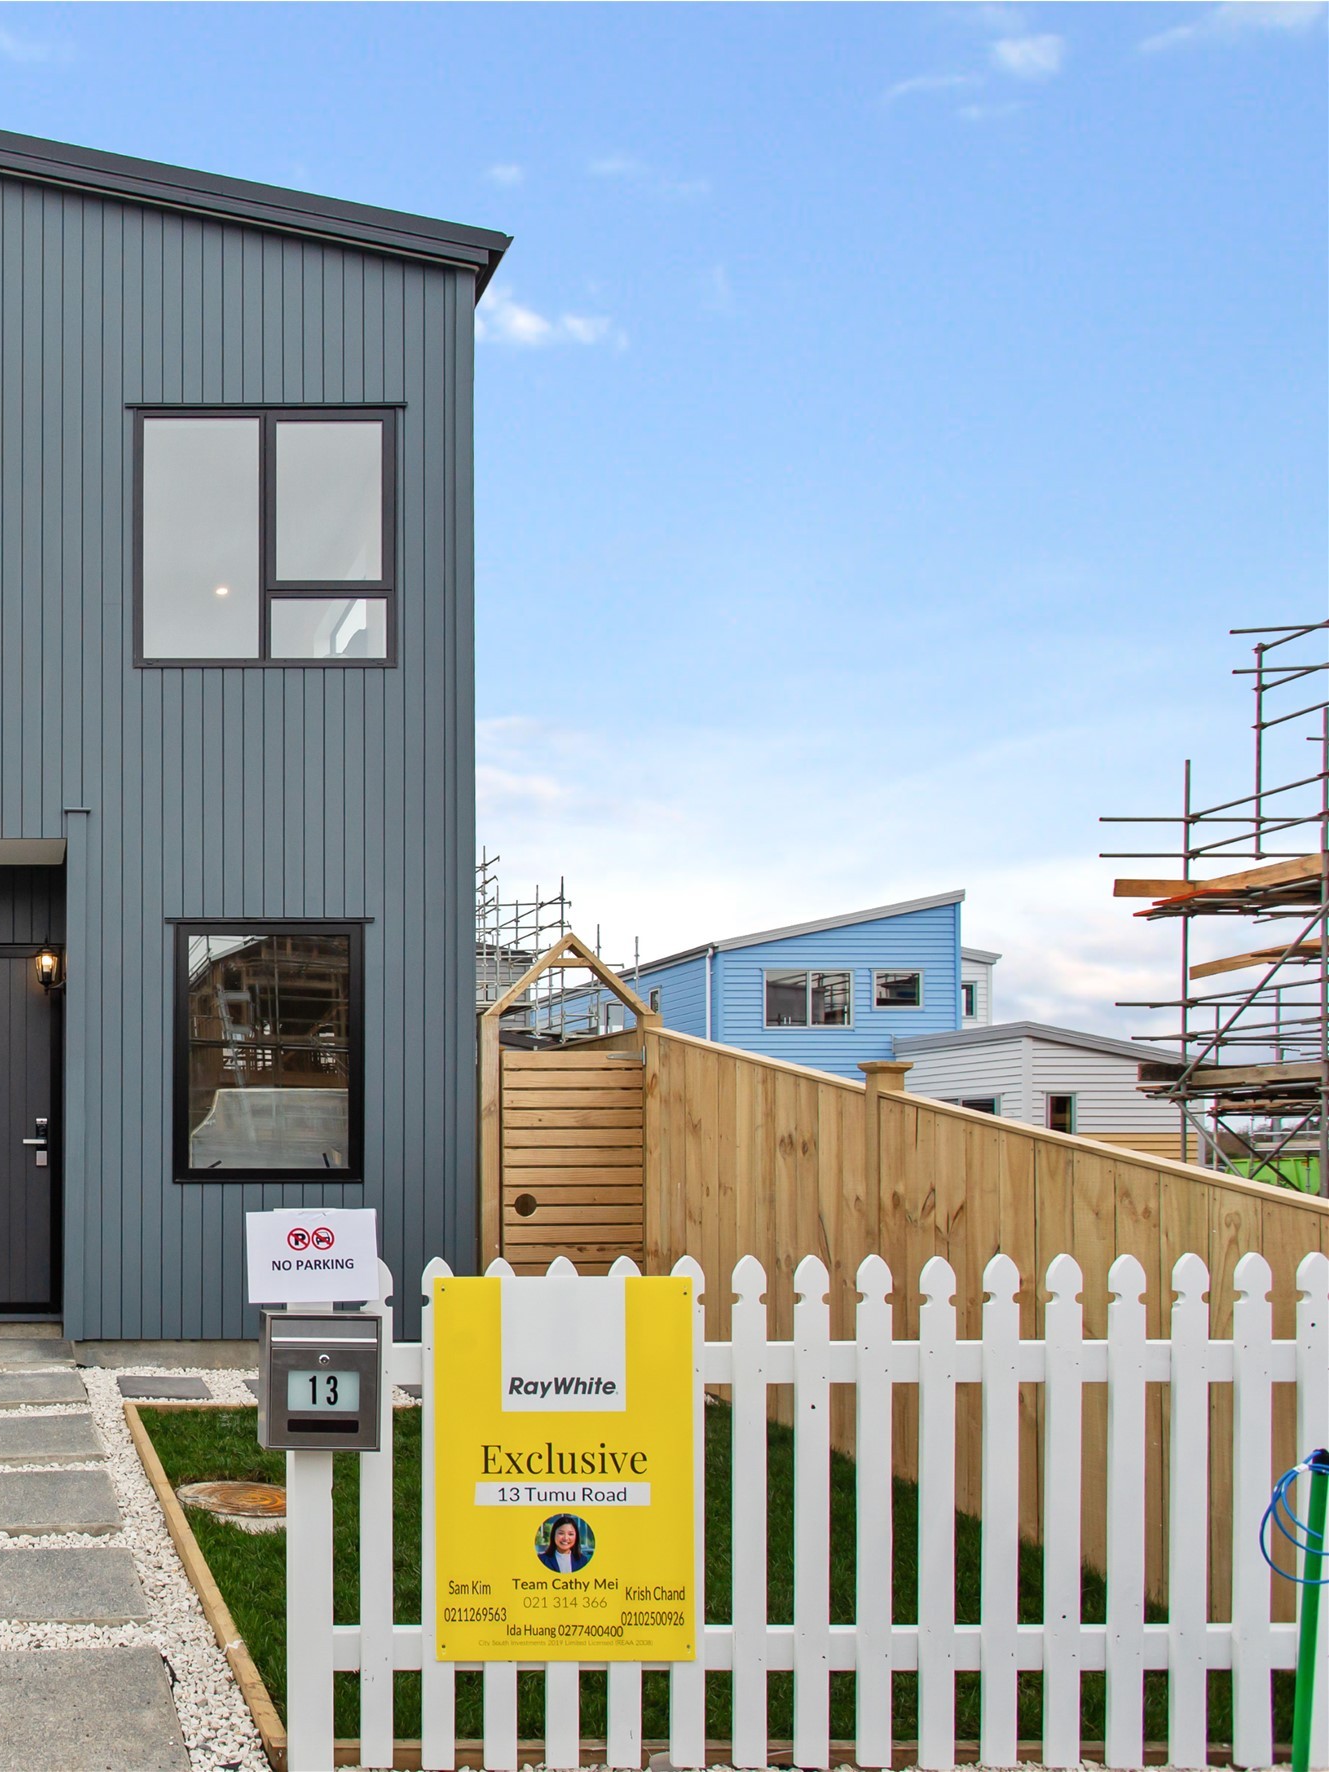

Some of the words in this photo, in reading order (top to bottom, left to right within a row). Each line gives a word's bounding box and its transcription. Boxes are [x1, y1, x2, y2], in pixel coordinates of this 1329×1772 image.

[271, 1260, 292, 1271] NO
[296, 1258, 354, 1270] PARKING
[309, 1375, 339, 1406] 13
[481, 1442, 648, 1475] Exclusive
[498, 1487, 520, 1502] 13
[525, 1487, 576, 1502] Tumu
[582, 1487, 627, 1502] Road
[448, 1580, 470, 1595] Sam
[472, 1580, 491, 1595] Kim
[512, 1578, 548, 1590] Team
[552, 1578, 591, 1593] Cathy
[594, 1578, 619, 1590] Mei
[625, 1586, 652, 1601] Krish
[653, 1586, 686, 1601] Chand
[523, 1597, 547, 1608] 021
[553, 1597, 578, 1608] 314
[582, 1597, 608, 1608] 366
[444, 1607, 507, 1622] 0211269563
[621, 1611, 685, 1626] 02102500926
[506, 1624, 522, 1637] Ida
[524, 1624, 556, 1638] Huang
[558, 1624, 624, 1637] 0277400400
